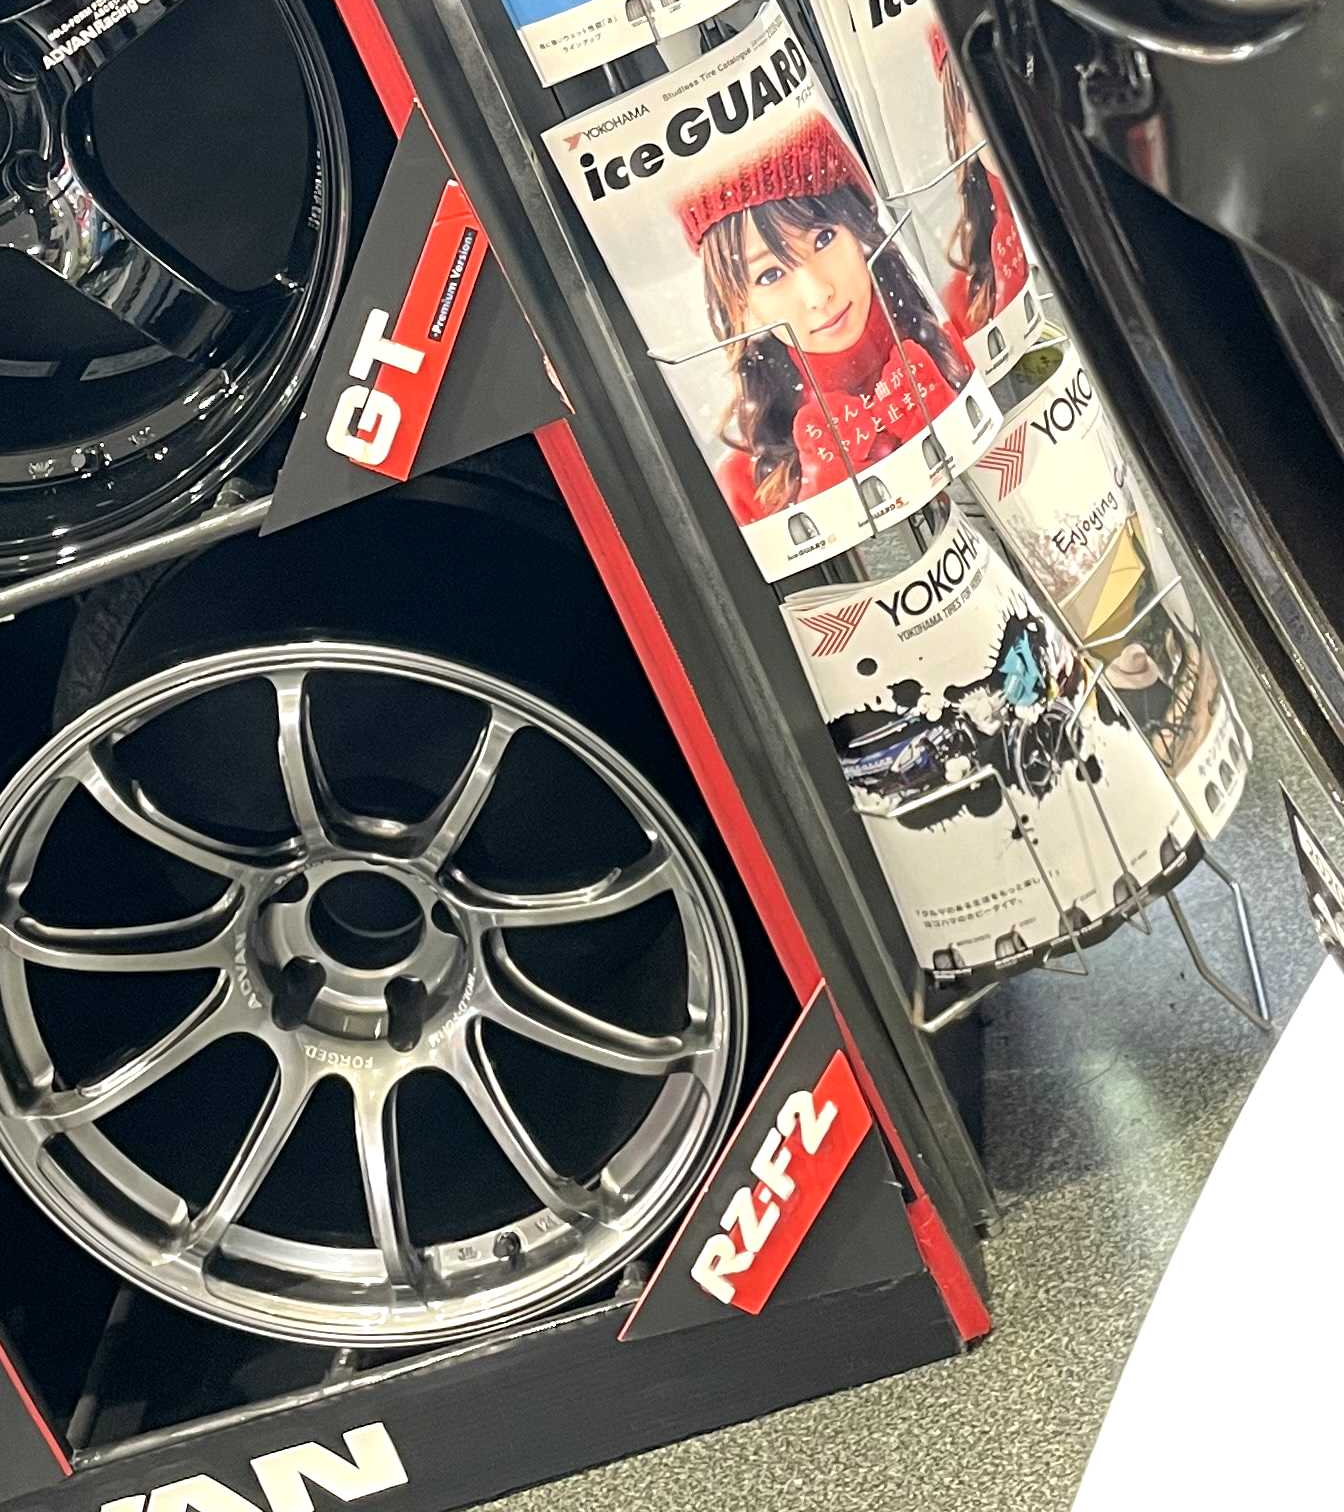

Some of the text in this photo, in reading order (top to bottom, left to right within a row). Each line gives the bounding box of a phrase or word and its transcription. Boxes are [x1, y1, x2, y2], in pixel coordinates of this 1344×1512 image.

[582, 103, 650, 142] YOKOHAMA
[326, 308, 425, 466] GT
[1052, 490, 1119, 554] Enjoying
[898, 613, 944, 642] YOKOHAMA
[235, 933, 262, 1008] ADVAN
[305, 1044, 374, 1069] FORGED
[691, 1090, 838, 1304] RZ-F2
